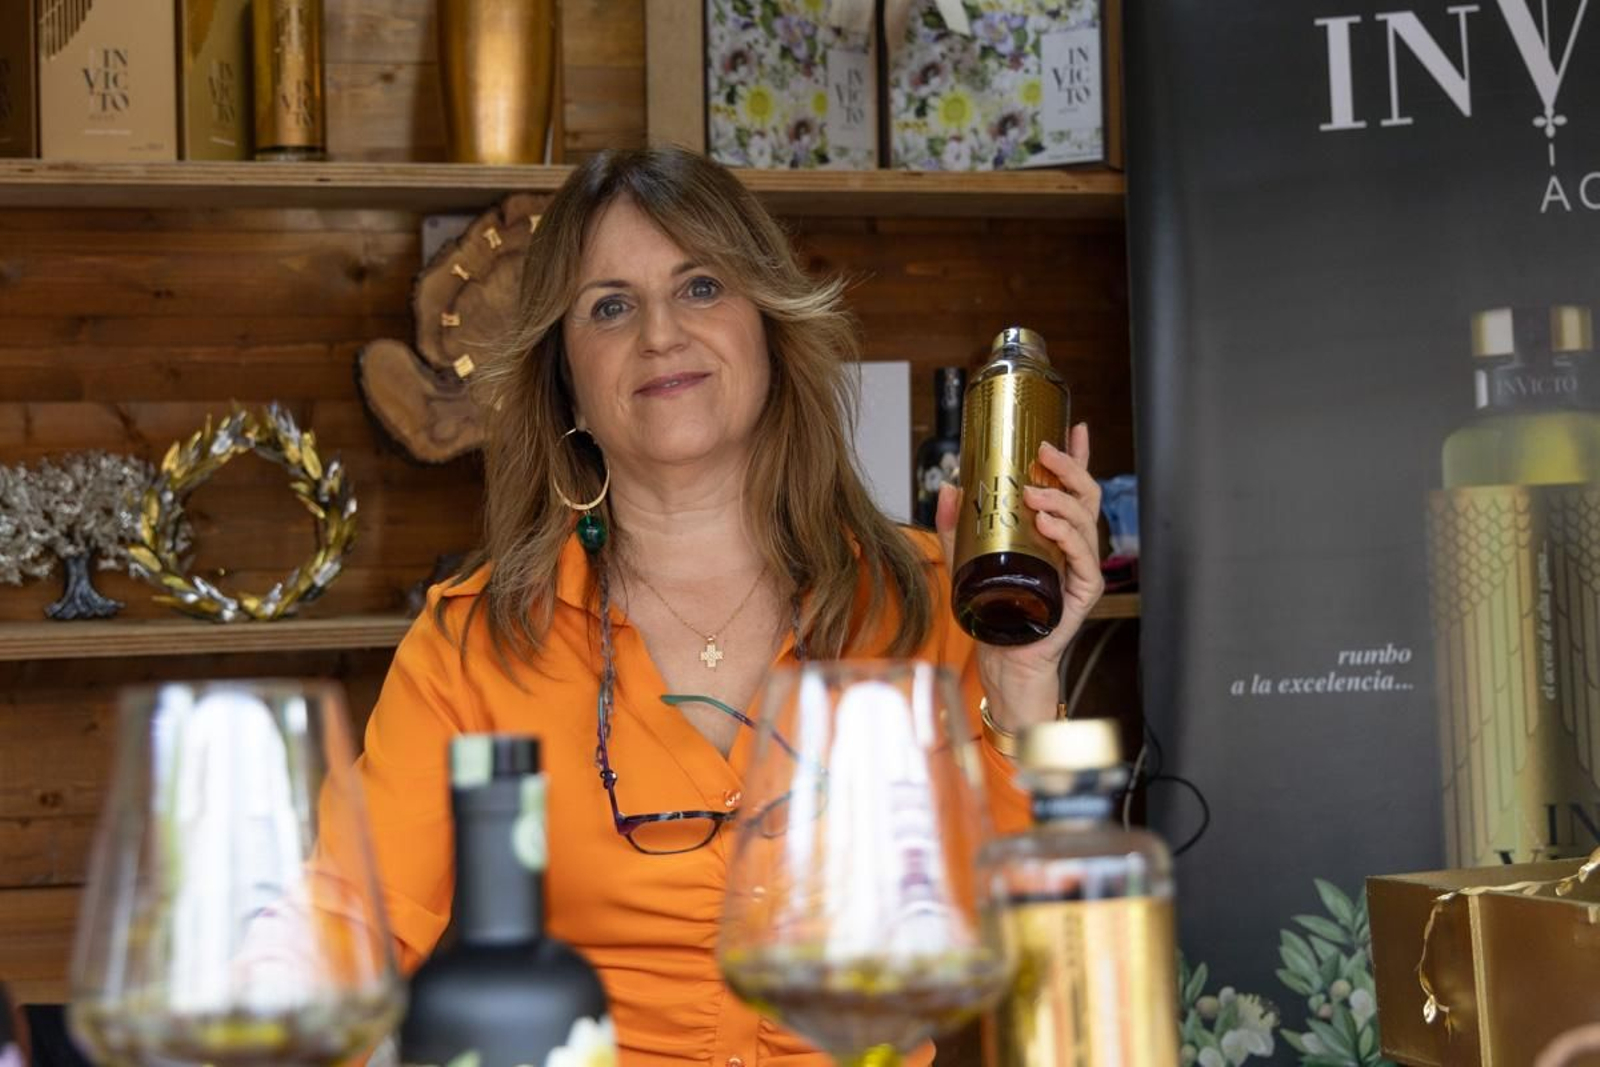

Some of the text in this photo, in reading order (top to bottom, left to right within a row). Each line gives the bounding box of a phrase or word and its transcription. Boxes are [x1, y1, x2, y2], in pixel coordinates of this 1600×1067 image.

[102, 48, 129, 68] IN
[1066, 46, 1090, 65] IN
[82, 67, 129, 95] VIC
[1052, 67, 1090, 90] VIC
[97, 91, 130, 112] TO
[1066, 86, 1091, 105] TO
[993, 474, 1020, 492] IN
[1338, 643, 1412, 666] rumbo
[1230, 669, 1414, 696] a la excelencia...
[1539, 686, 1556, 700] el
